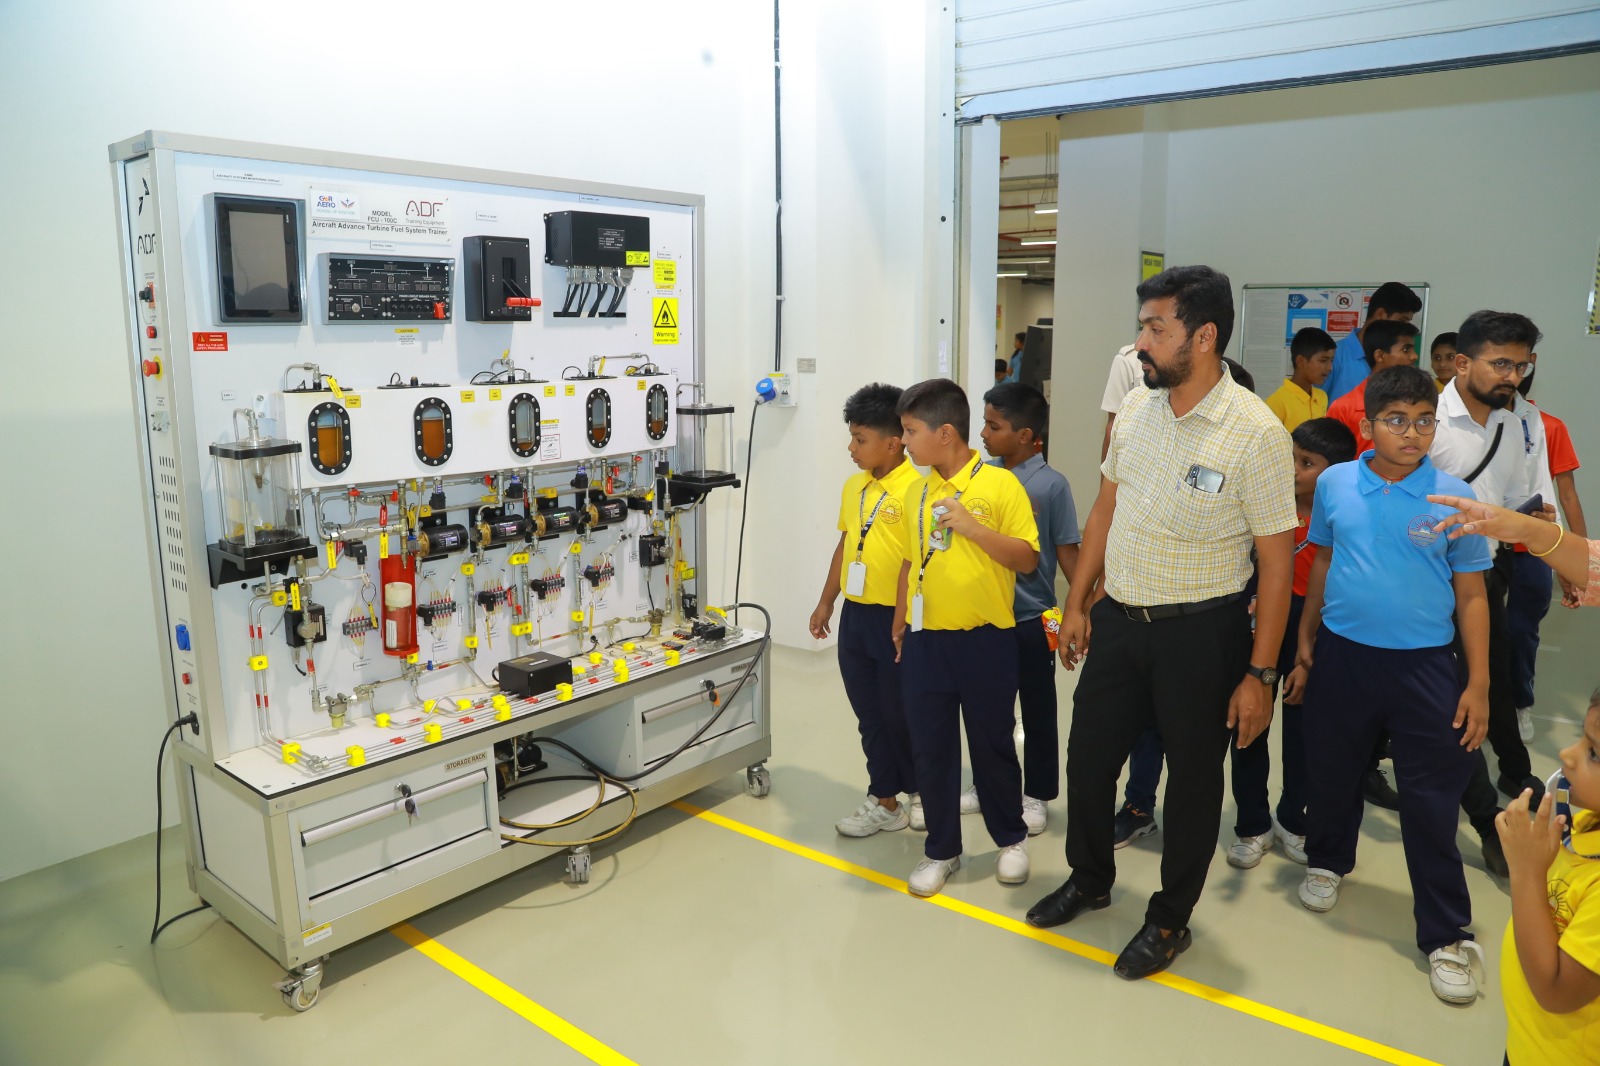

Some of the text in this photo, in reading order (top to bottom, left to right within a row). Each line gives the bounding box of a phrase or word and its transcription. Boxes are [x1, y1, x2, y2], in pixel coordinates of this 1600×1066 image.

[405, 200, 444, 218] ADF
[312, 220, 337, 229] Aircraft
[338, 222, 366, 231] Advance
[367, 224, 390, 232] Turbine
[405, 227, 427, 235] System
[446, 752, 486, 770] STORAGE RACK
